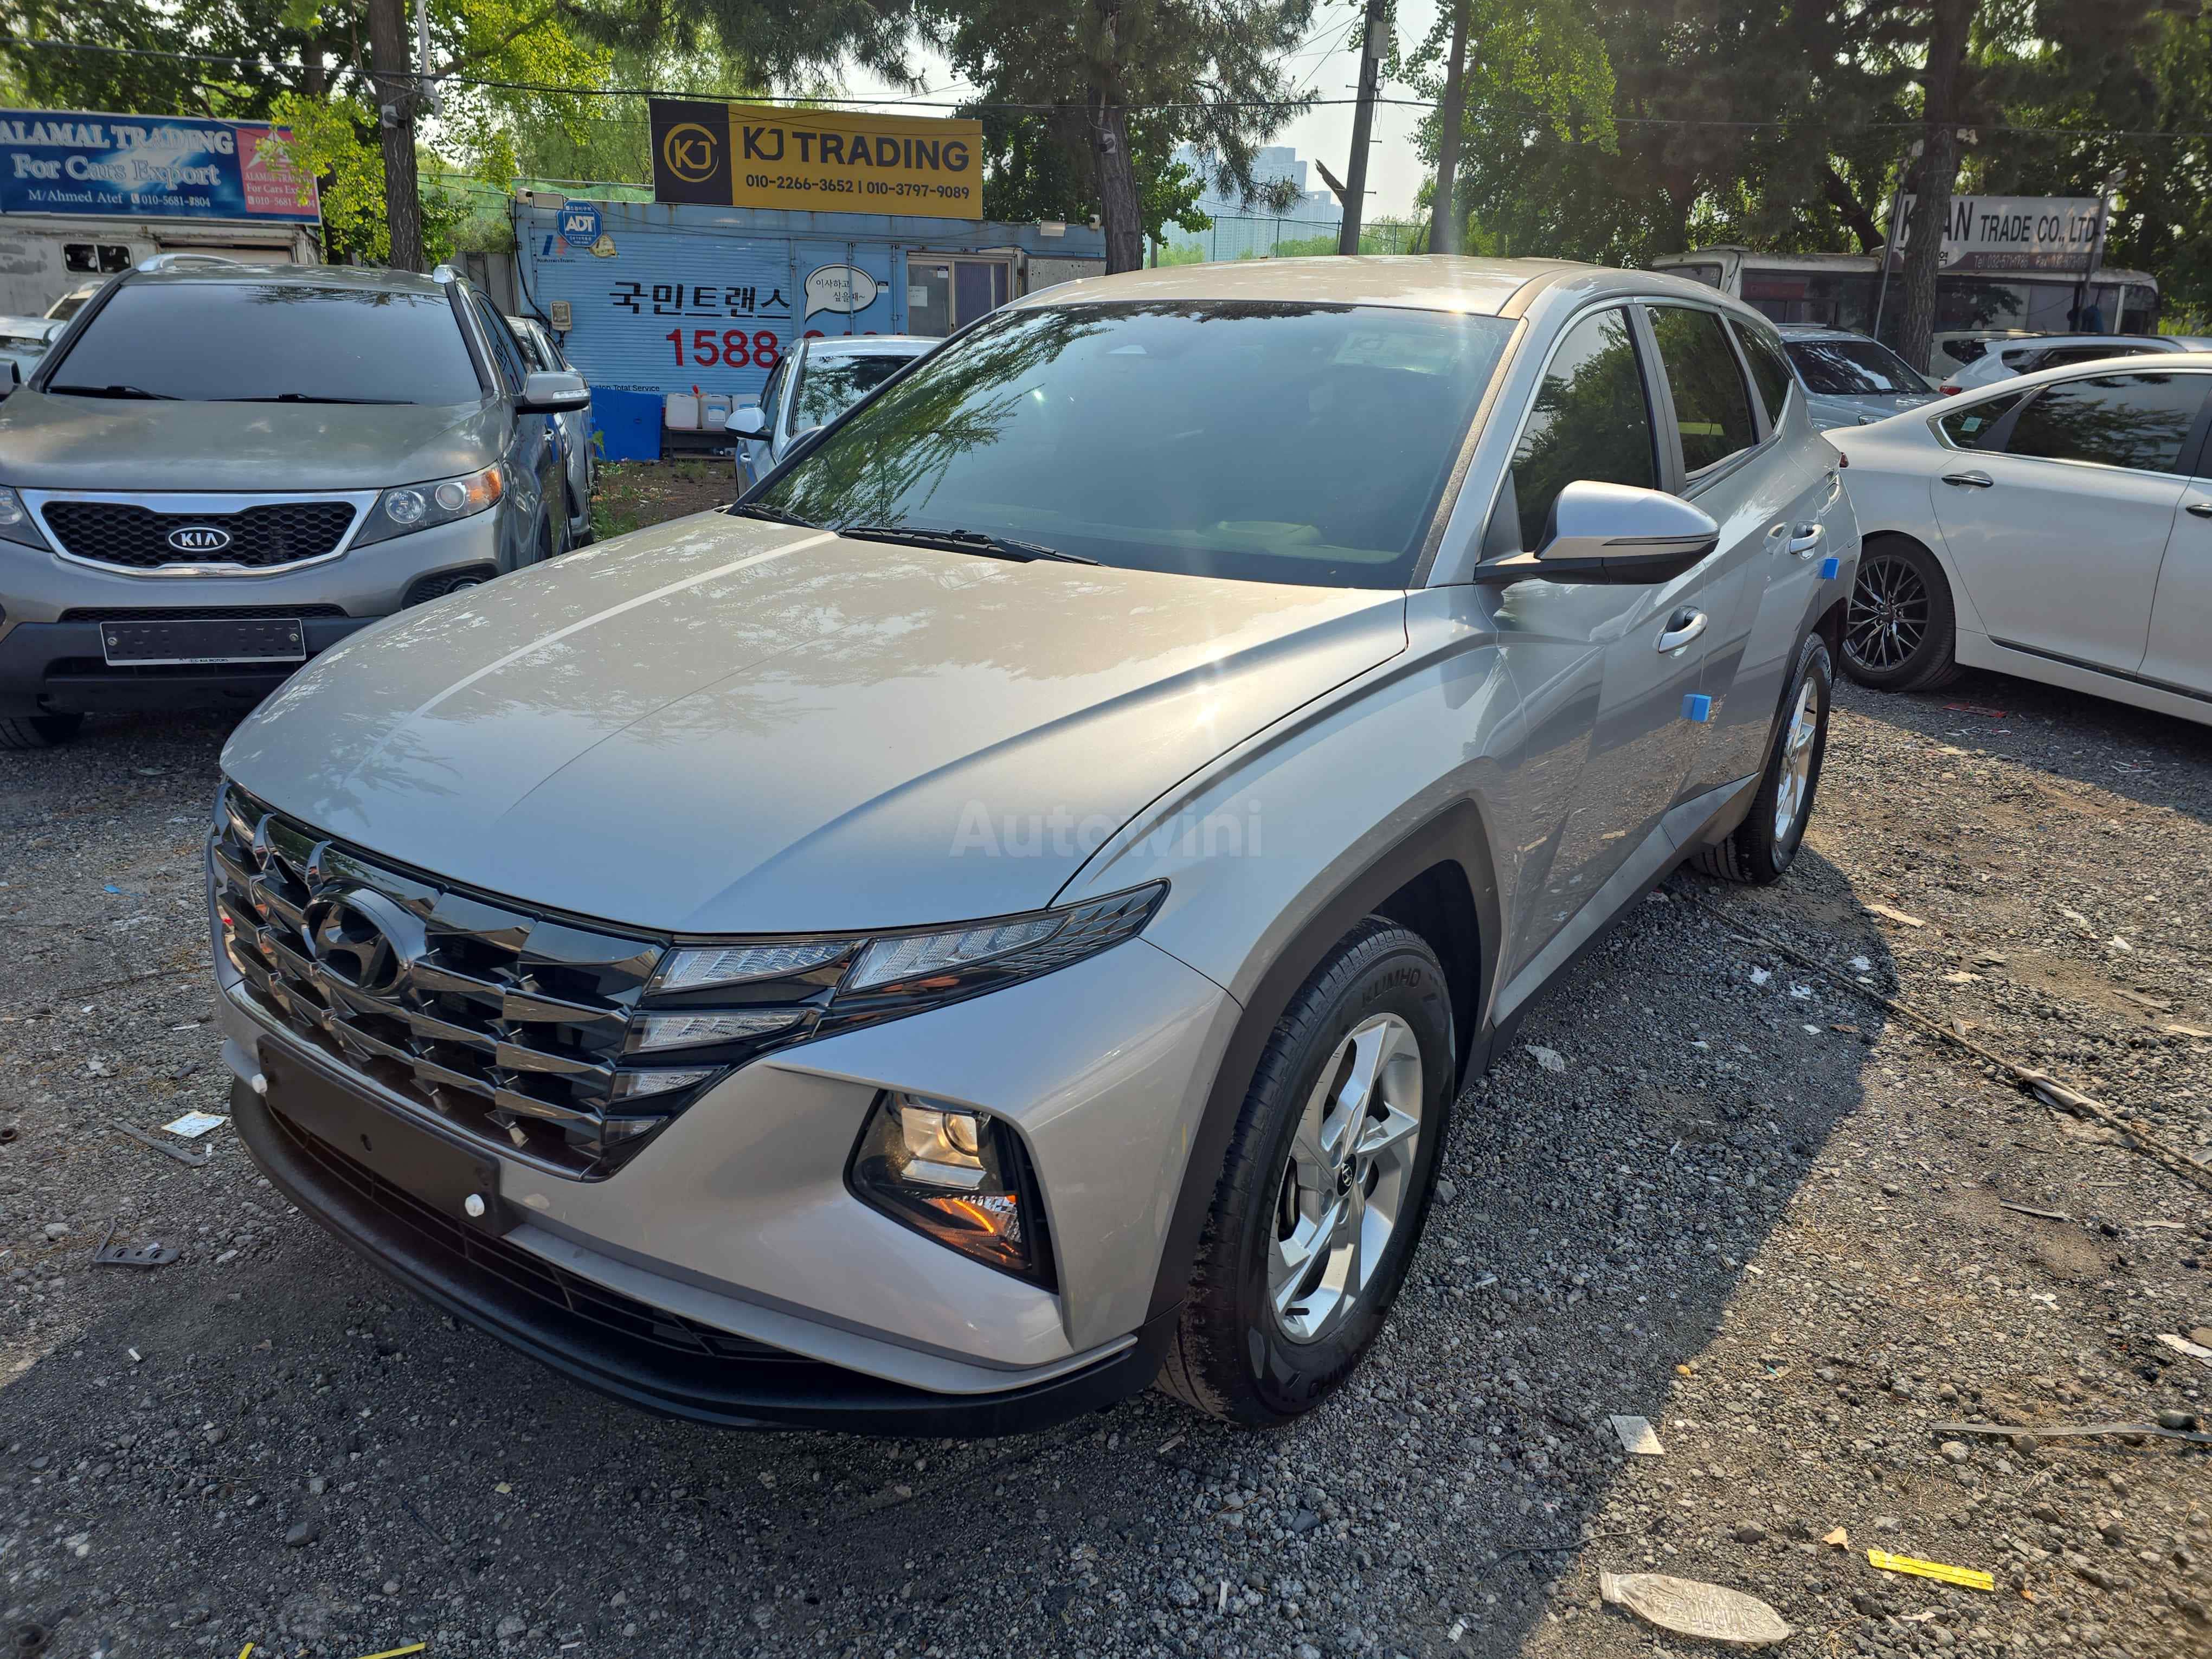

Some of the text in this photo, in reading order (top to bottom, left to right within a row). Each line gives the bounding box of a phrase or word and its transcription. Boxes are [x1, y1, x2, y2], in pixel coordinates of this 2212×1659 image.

[0, 120, 234, 155] ALAMAL TRADING
[743, 126, 970, 172] KJ TRADING
[674, 139, 711, 170] KJ
[11, 153, 222, 190] For Cars Export
[28, 190, 93, 203] M/Ahmed
[97, 191, 123, 204] Atef
[247, 182, 261, 192] For
[263, 184, 284, 193] Cars
[746, 174, 853, 192] 010-2266-3652
[867, 181, 970, 199] 010-3797-9089
[565, 216, 594, 232] ADT
[1980, 215, 2033, 242] TRADE
[816, 279, 850, 289] 이사하고
[609, 282, 792, 319] 국민트랜스
[179, 533, 219, 546] KIA
[1362, 968, 1422, 1008] KUMHO
